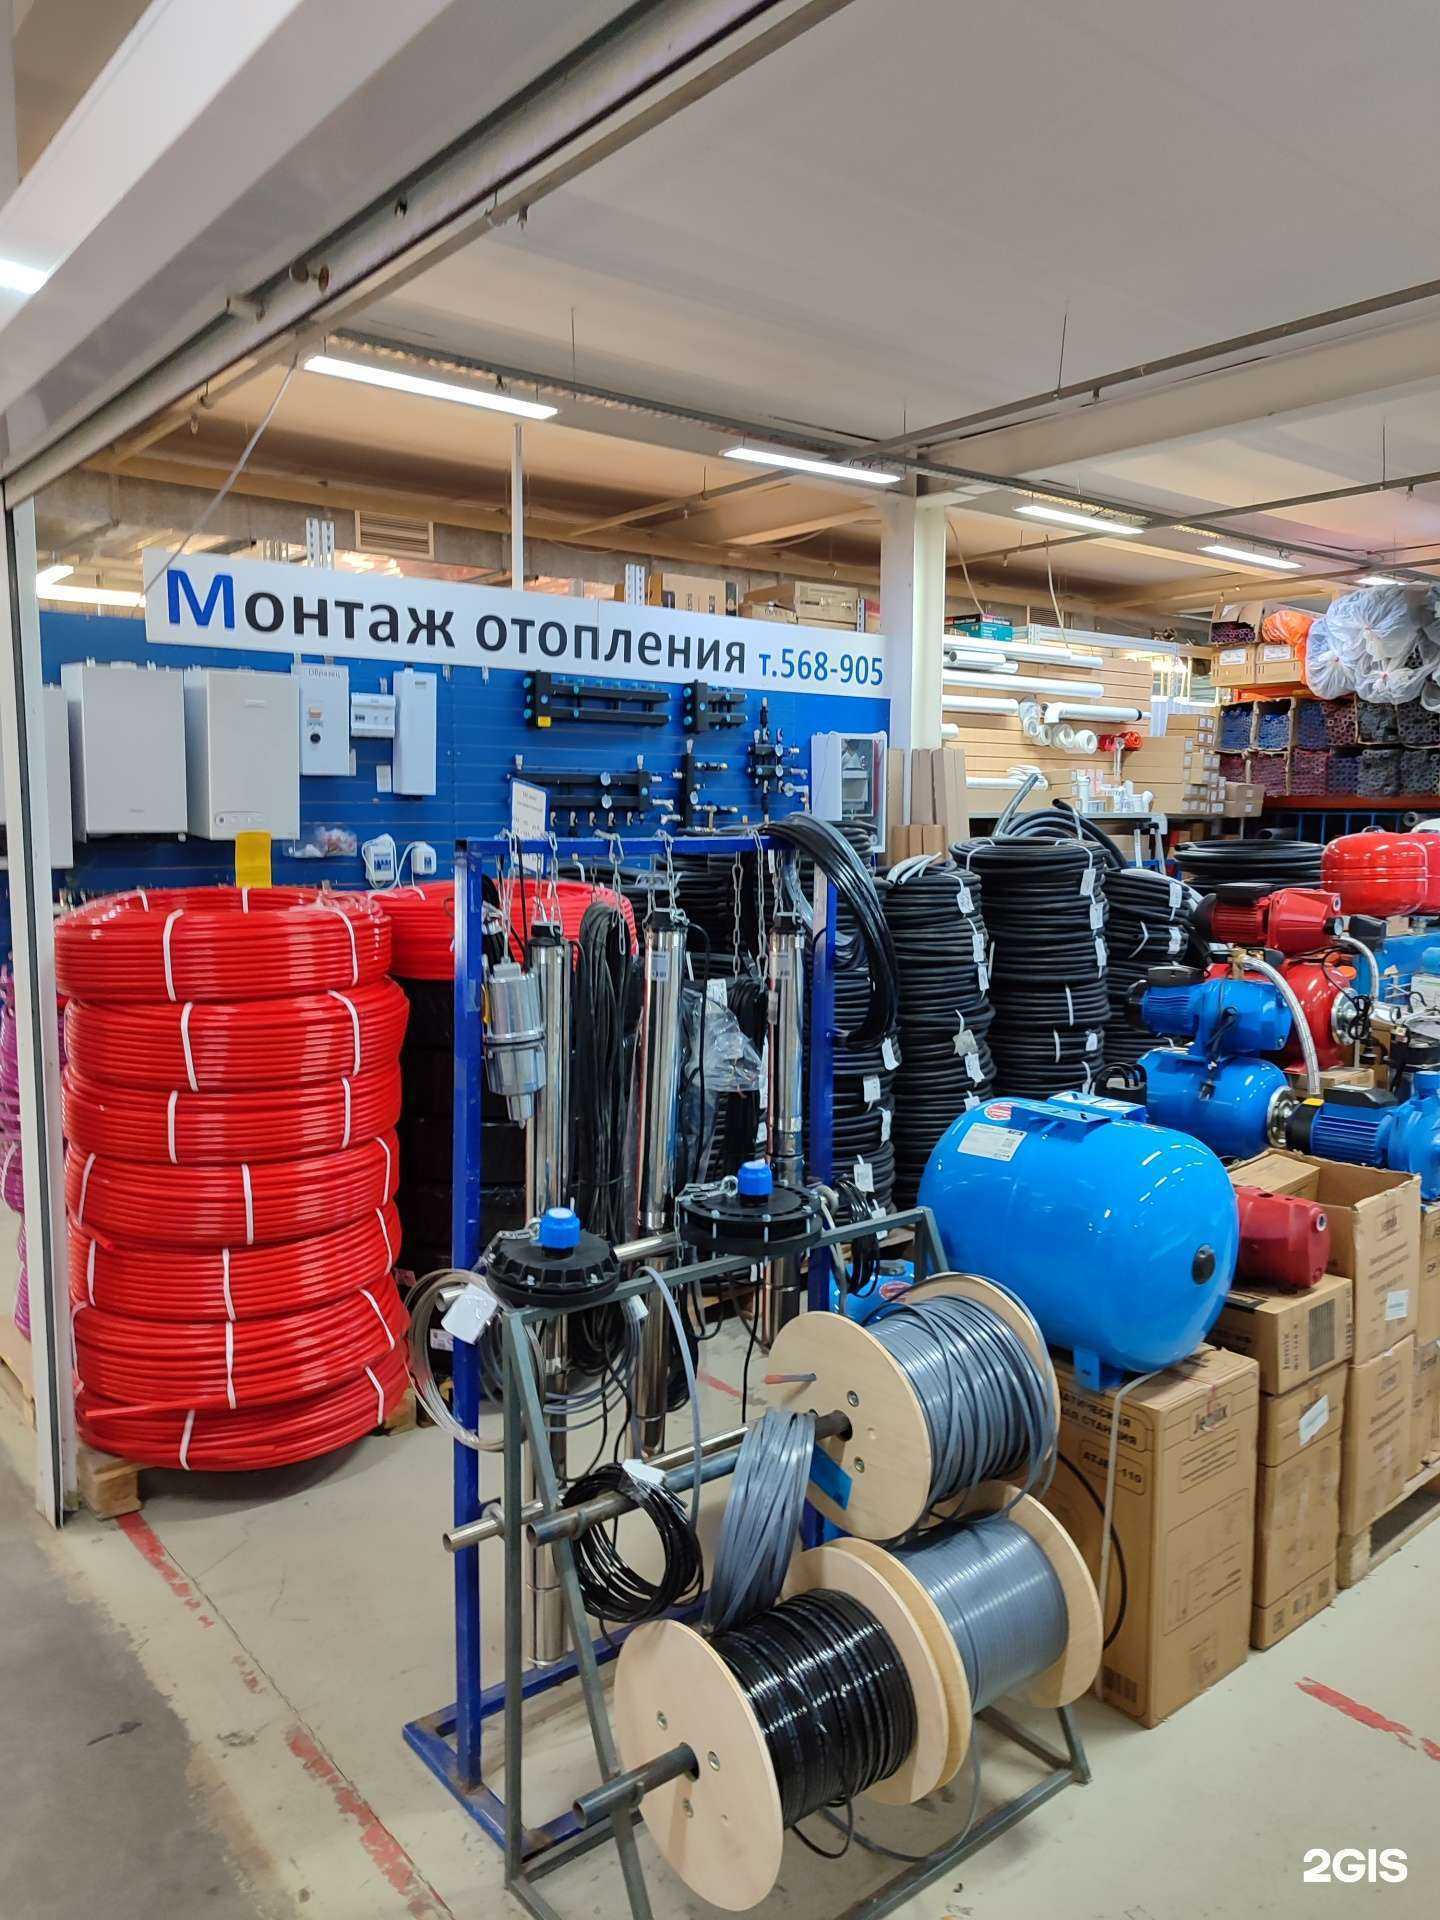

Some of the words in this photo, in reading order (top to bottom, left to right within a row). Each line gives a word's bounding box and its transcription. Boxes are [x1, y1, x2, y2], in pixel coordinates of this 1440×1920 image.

[166, 568, 456, 648] Монтаж
[475, 614, 746, 674] отопления
[758, 648, 884, 686] т.568-905
